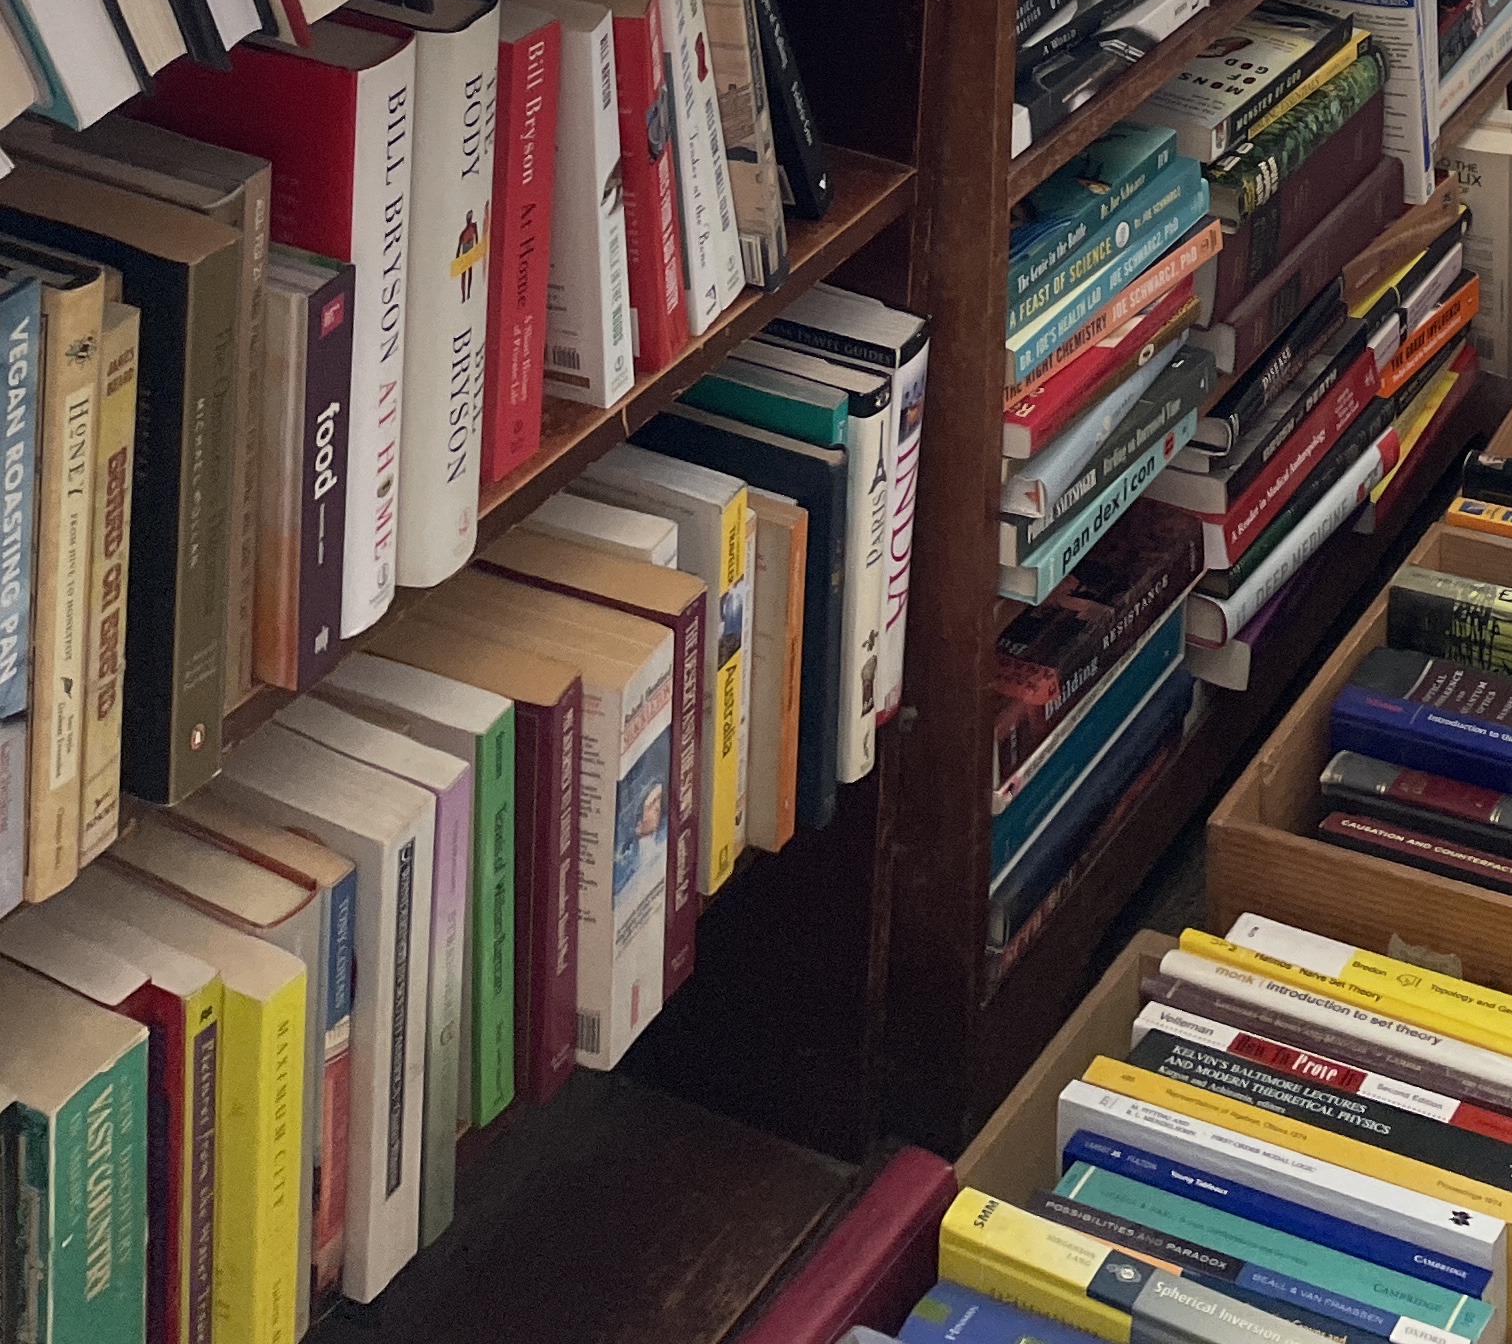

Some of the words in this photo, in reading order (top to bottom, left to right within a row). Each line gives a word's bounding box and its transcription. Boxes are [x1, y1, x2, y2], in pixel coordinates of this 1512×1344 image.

[384, 85, 408, 188] BILL
[461, 73, 484, 181] BODY
[377, 191, 406, 365] BRYSON
[1008, 309, 1017, 330] A
[1020, 286, 1051, 320] FEAST
[1053, 271, 1068, 293] OF
[1069, 236, 1112, 282] SCIENCE
[313, 401, 341, 500] food
[377, 378, 397, 433] AT
[447, 327, 473, 485] BRYSON
[374, 440, 396, 563] HOME
[866, 489, 888, 569] PARIS
[885, 441, 920, 629] INDIA
[1341, 819, 1404, 843] CAUSATION
[1406, 837, 1432, 850] AND
[1045, 1199, 1135, 1238] POSSIBILITIES
[1138, 1230, 1163, 1248] AND
[1165, 1238, 1228, 1271] PARADOX
